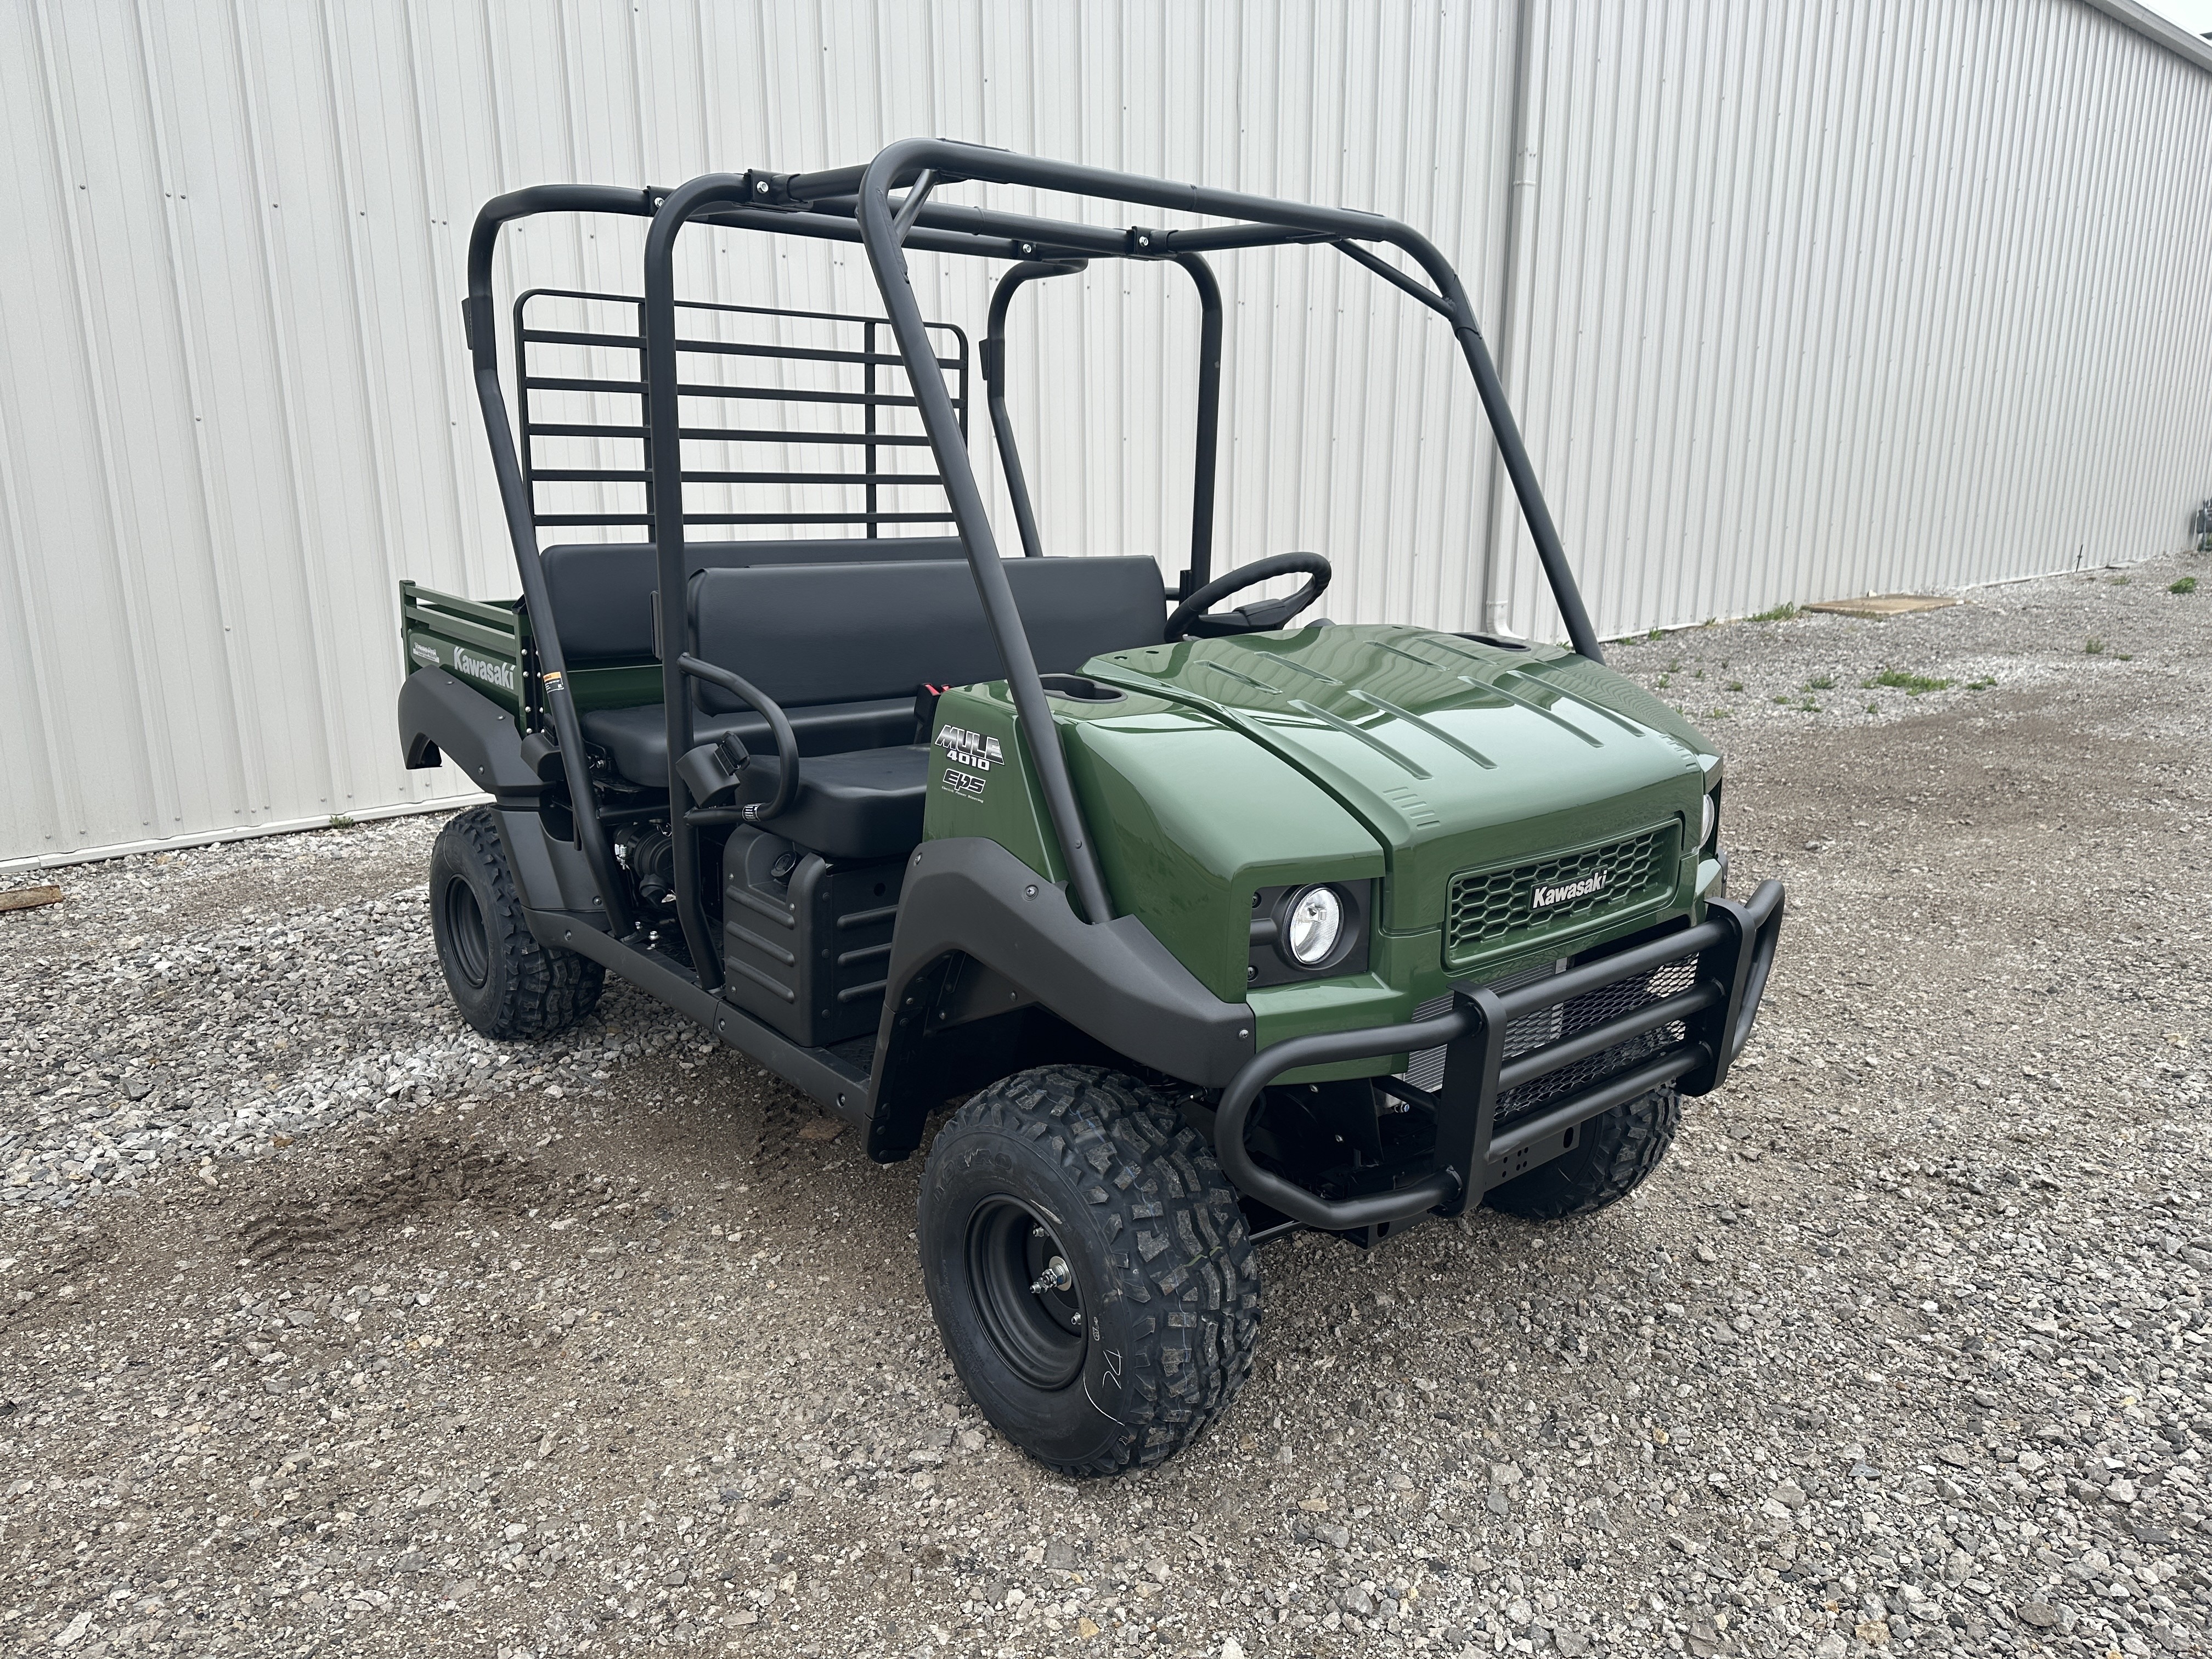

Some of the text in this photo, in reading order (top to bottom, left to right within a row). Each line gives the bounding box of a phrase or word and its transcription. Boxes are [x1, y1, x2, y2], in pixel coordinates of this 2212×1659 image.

[454, 646, 516, 690] Kawasaki
[934, 724, 1005, 765] MULE
[946, 751, 990, 771] 4010
[968, 795, 984, 803] Steering
[1533, 870, 1607, 909] Kawasaki
